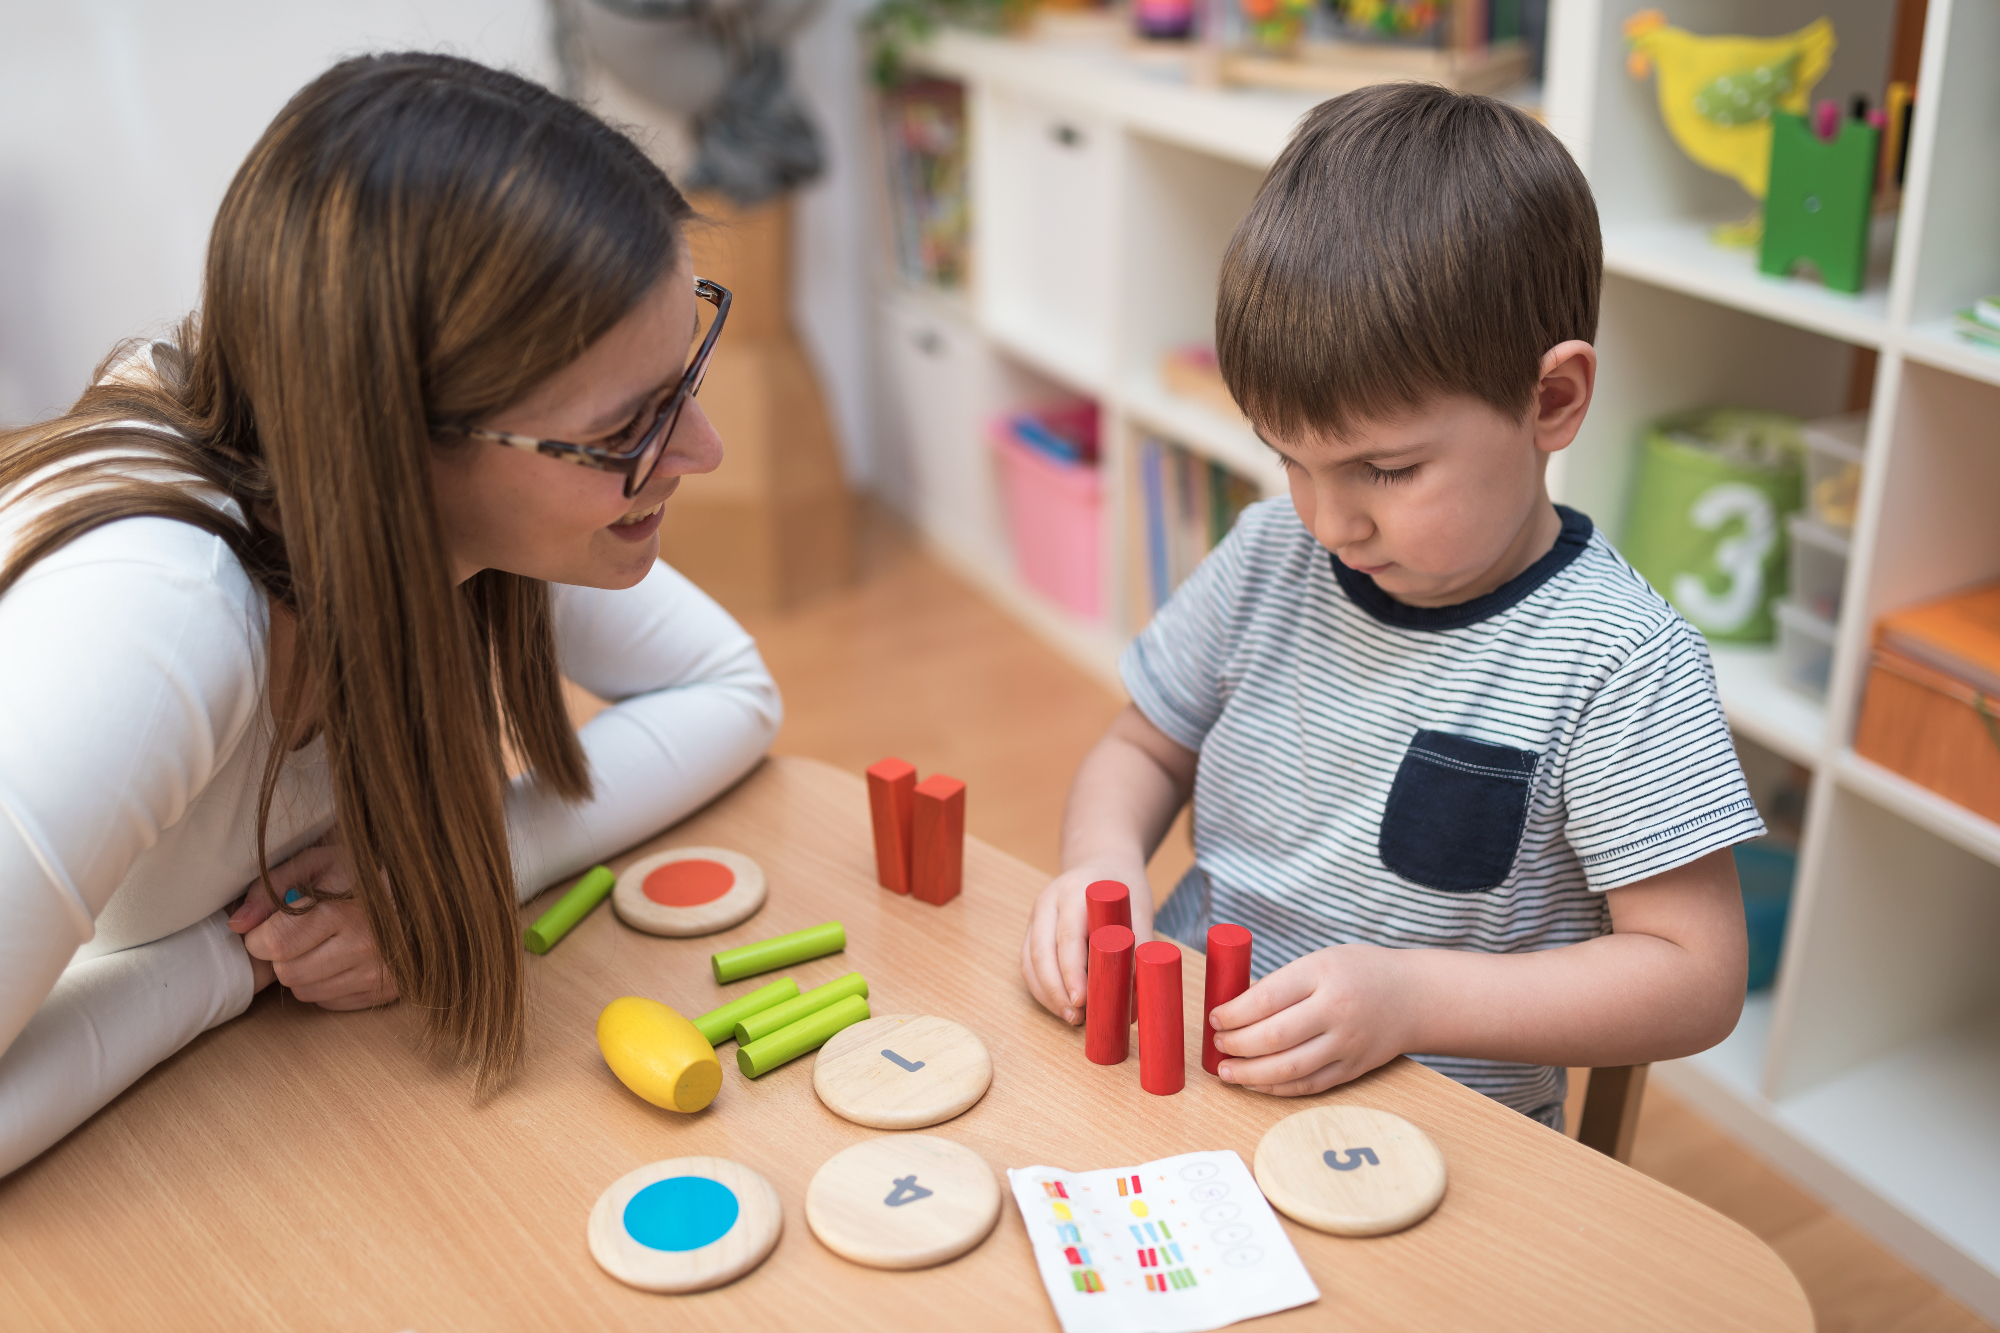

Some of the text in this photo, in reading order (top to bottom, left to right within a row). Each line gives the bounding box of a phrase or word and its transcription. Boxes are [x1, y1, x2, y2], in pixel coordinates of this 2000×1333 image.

[1670, 482, 1778, 634] 3
[881, 1049, 926, 1073] 1
[1322, 1147, 1381, 1172] 5
[884, 1175, 933, 1207] 4
